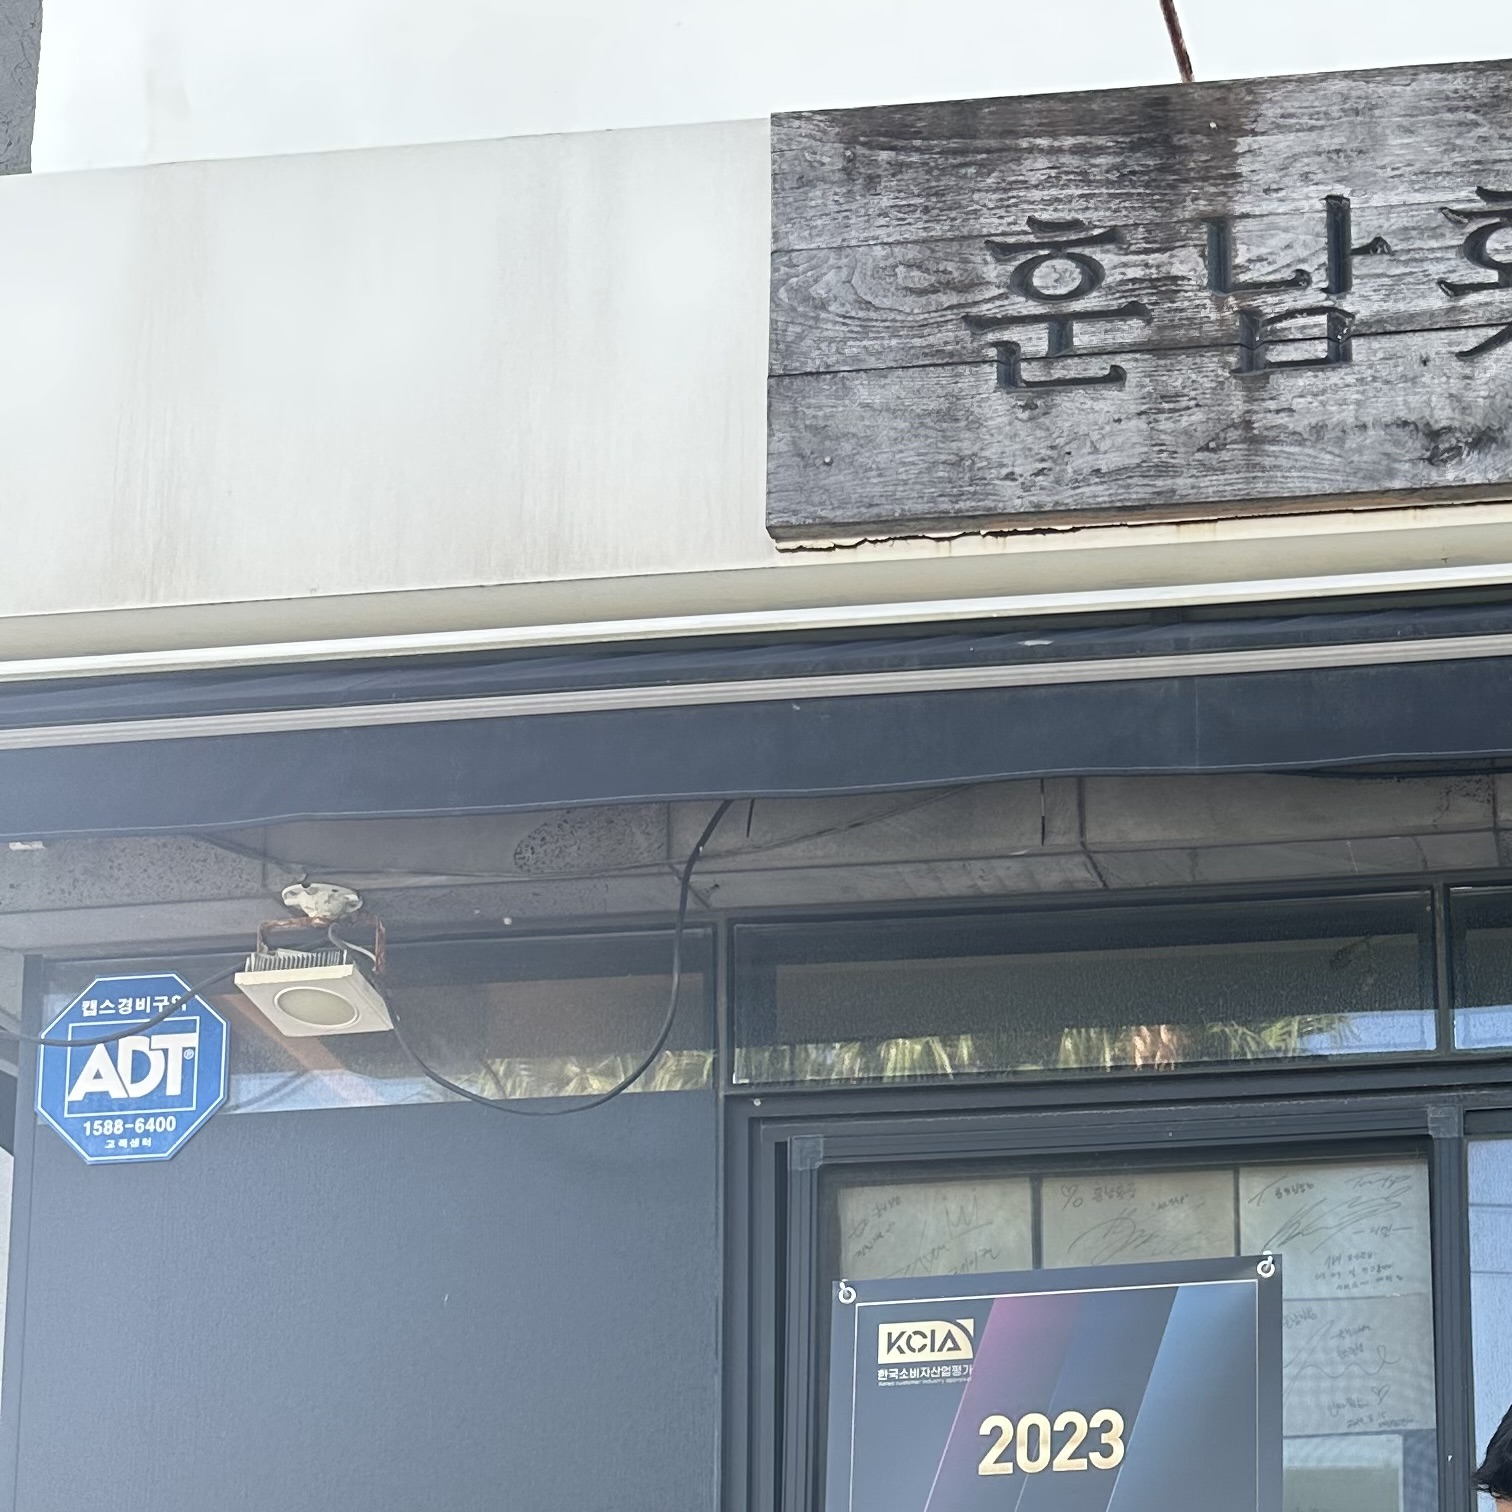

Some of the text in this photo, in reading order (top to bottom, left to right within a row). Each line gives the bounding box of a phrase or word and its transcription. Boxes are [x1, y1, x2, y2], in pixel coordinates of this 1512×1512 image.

[67, 1032, 198, 1102] ADT
[83, 1116, 177, 1136] 1588-6400
[886, 1328, 962, 1356] KCIA
[877, 1363, 974, 1381] 한국소비자산업평가
[977, 1408, 1126, 1476] 2023
